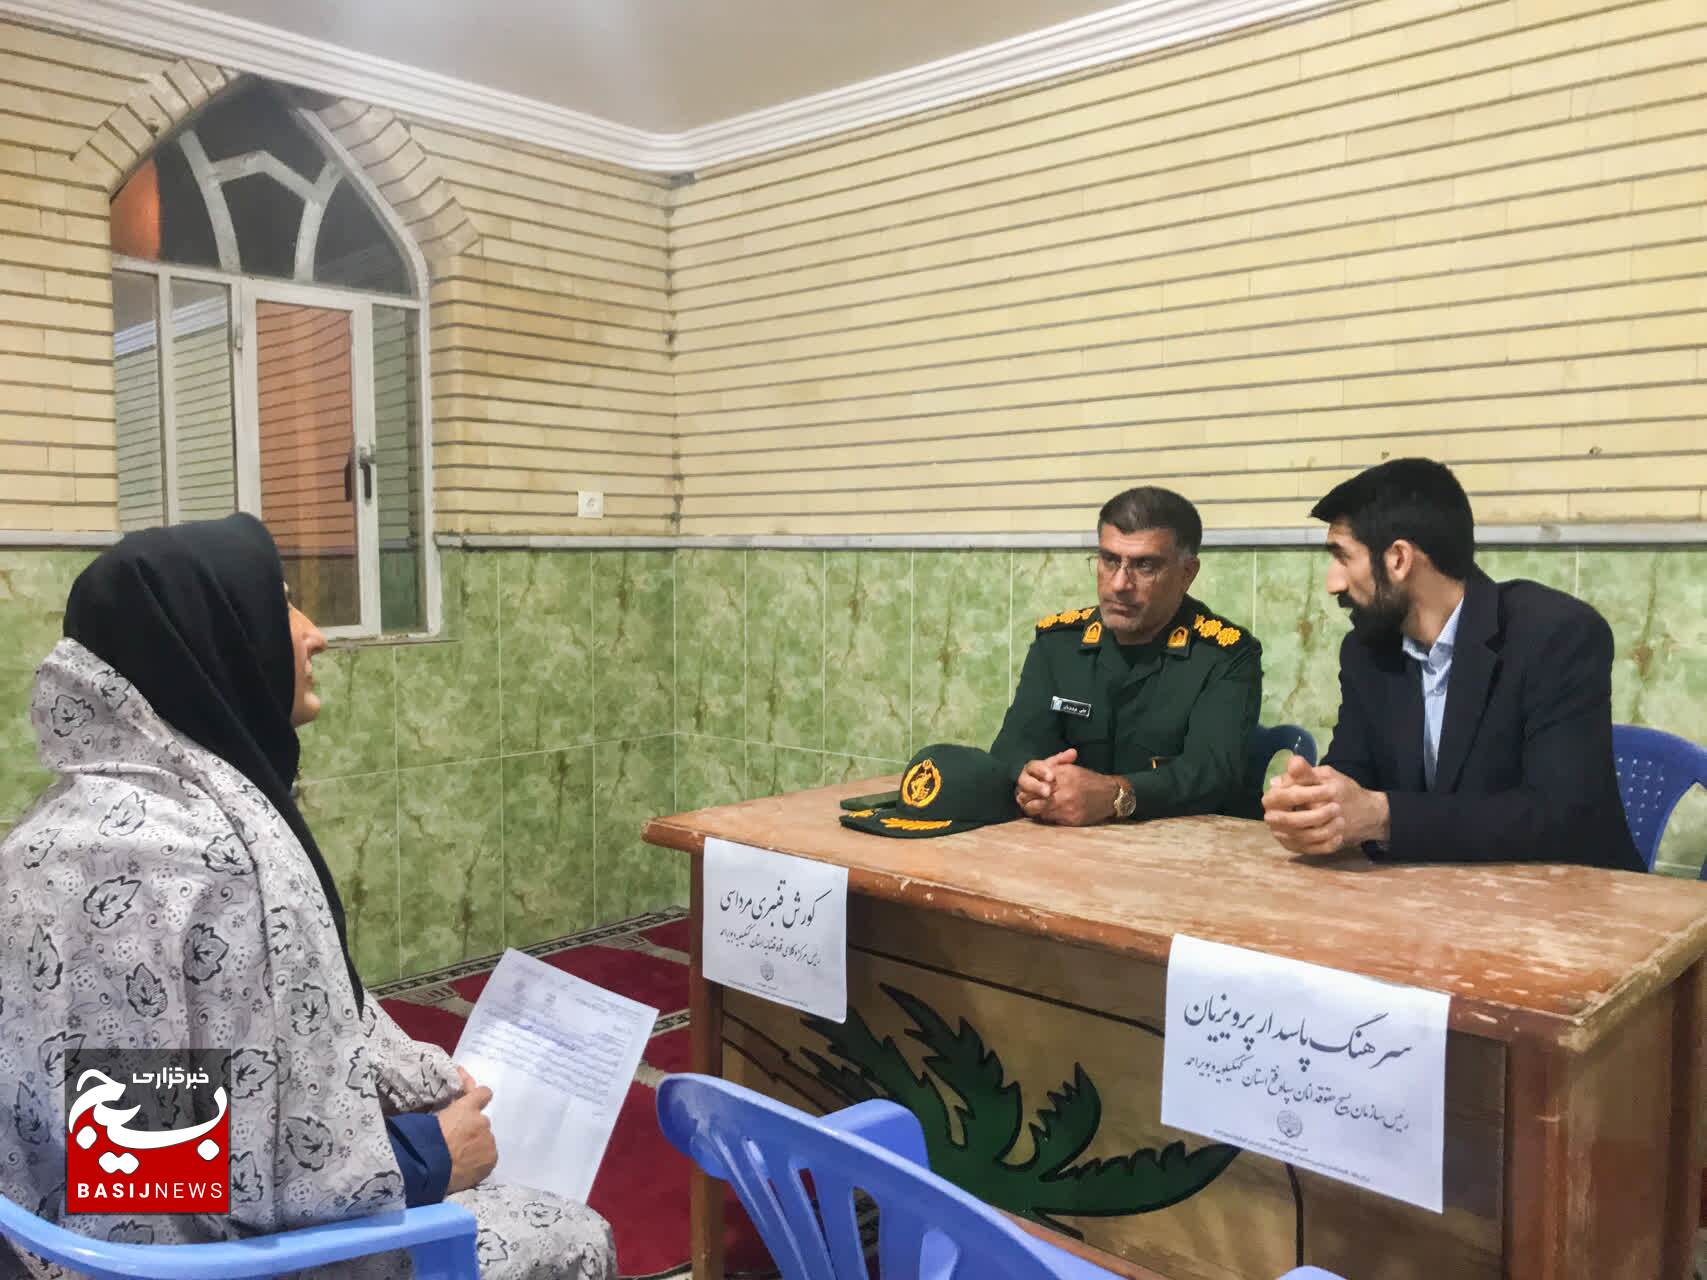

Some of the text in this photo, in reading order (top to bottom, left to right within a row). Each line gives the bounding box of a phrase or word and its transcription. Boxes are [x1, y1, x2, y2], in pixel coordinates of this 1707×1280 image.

[720, 879, 832, 928] کورش قنبری مرداسی
[1183, 992, 1412, 1073] سرهنگ پاسدار پرویزیان
[1184, 1056, 1210, 1078] بویراحمد
[1215, 1053, 1255, 1083] کهگیلویه
[1241, 1067, 1268, 1088] استان
[1266, 1065, 1281, 1097] فتح
[1278, 1079, 1295, 1105] سپاه
[1293, 1082, 1336, 1104] حقوقدانان
[1334, 1092, 1352, 1117] بسیج
[1350, 1103, 1385, 1120] سازمان
